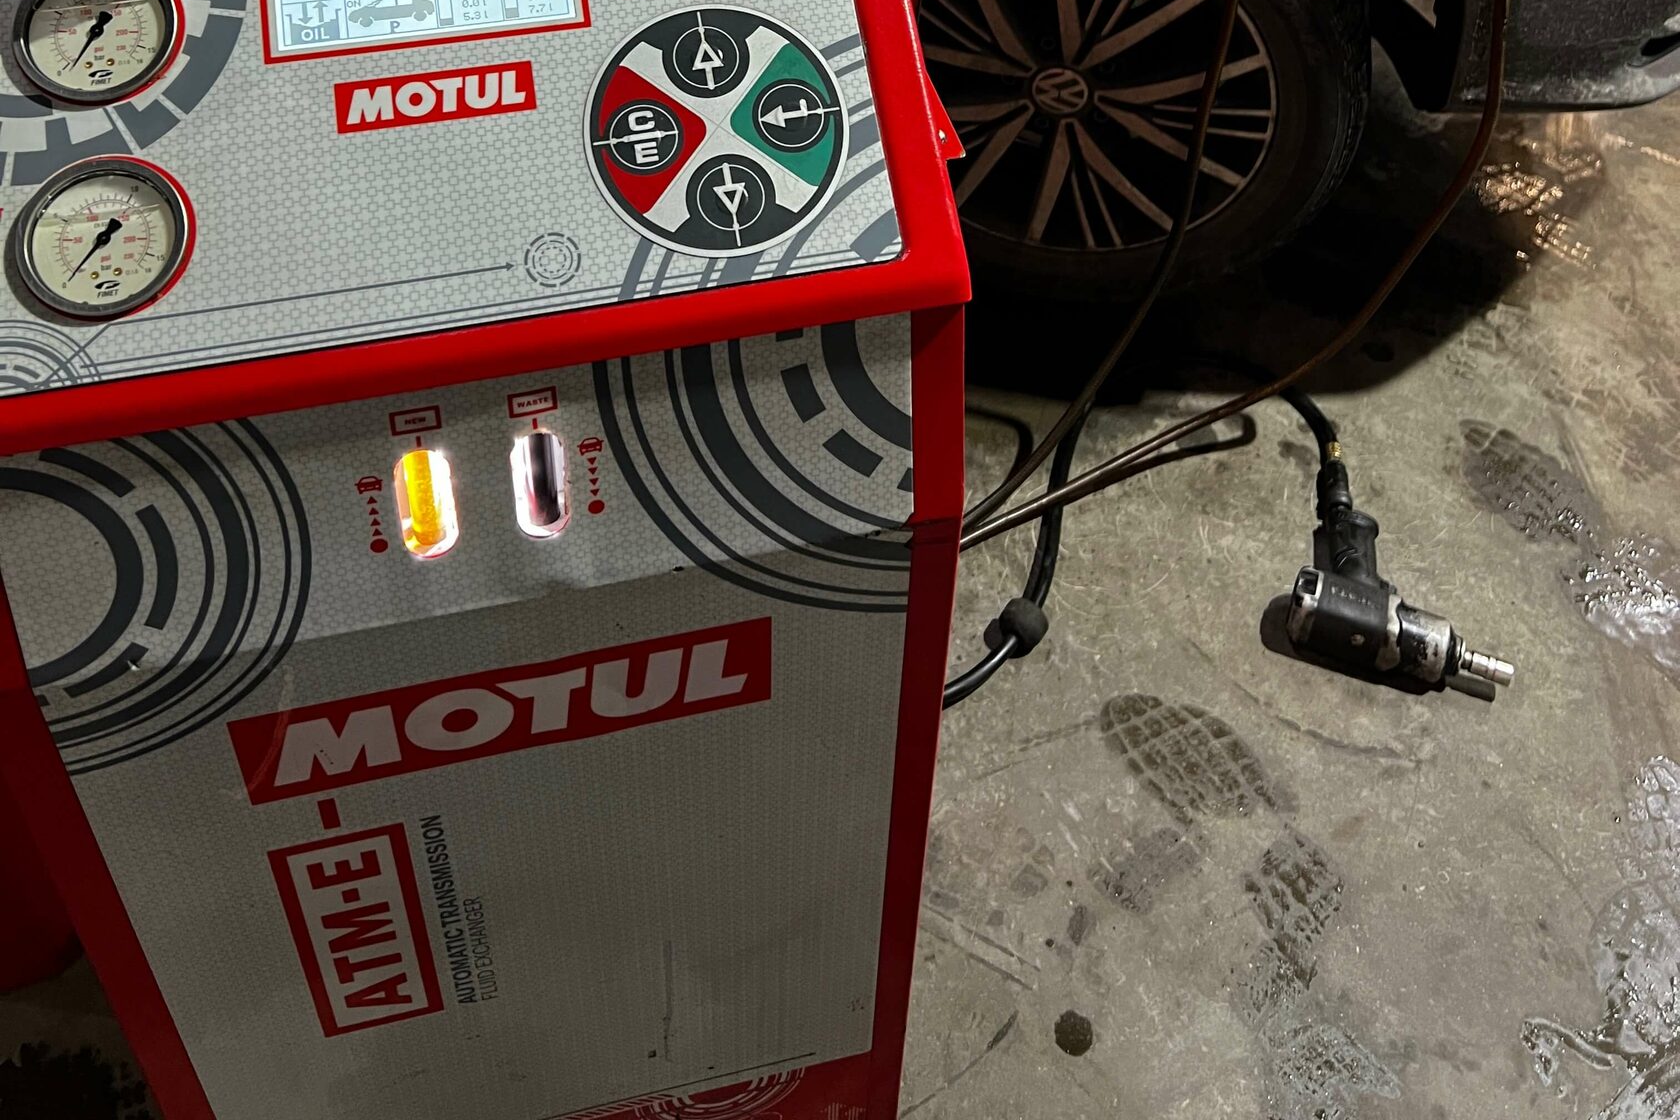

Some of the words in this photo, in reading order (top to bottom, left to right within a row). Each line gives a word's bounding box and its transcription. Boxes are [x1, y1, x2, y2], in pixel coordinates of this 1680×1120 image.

[346, 0, 361, 9] ON
[390, 20, 400, 33] P
[301, 27, 330, 42] OIL
[346, 70, 527, 125] MOTUL
[404, 416, 427, 426] NEW
[517, 396, 549, 409] WASTE
[273, 638, 749, 787] MOTUL
[419, 814, 460, 929] TRANSMISSION
[306, 849, 413, 1009] ATM-E
[463, 896, 493, 968] EXCHANGER
[444, 929, 477, 1004] AUTOMATIC
[476, 967, 499, 1001] FLUID
